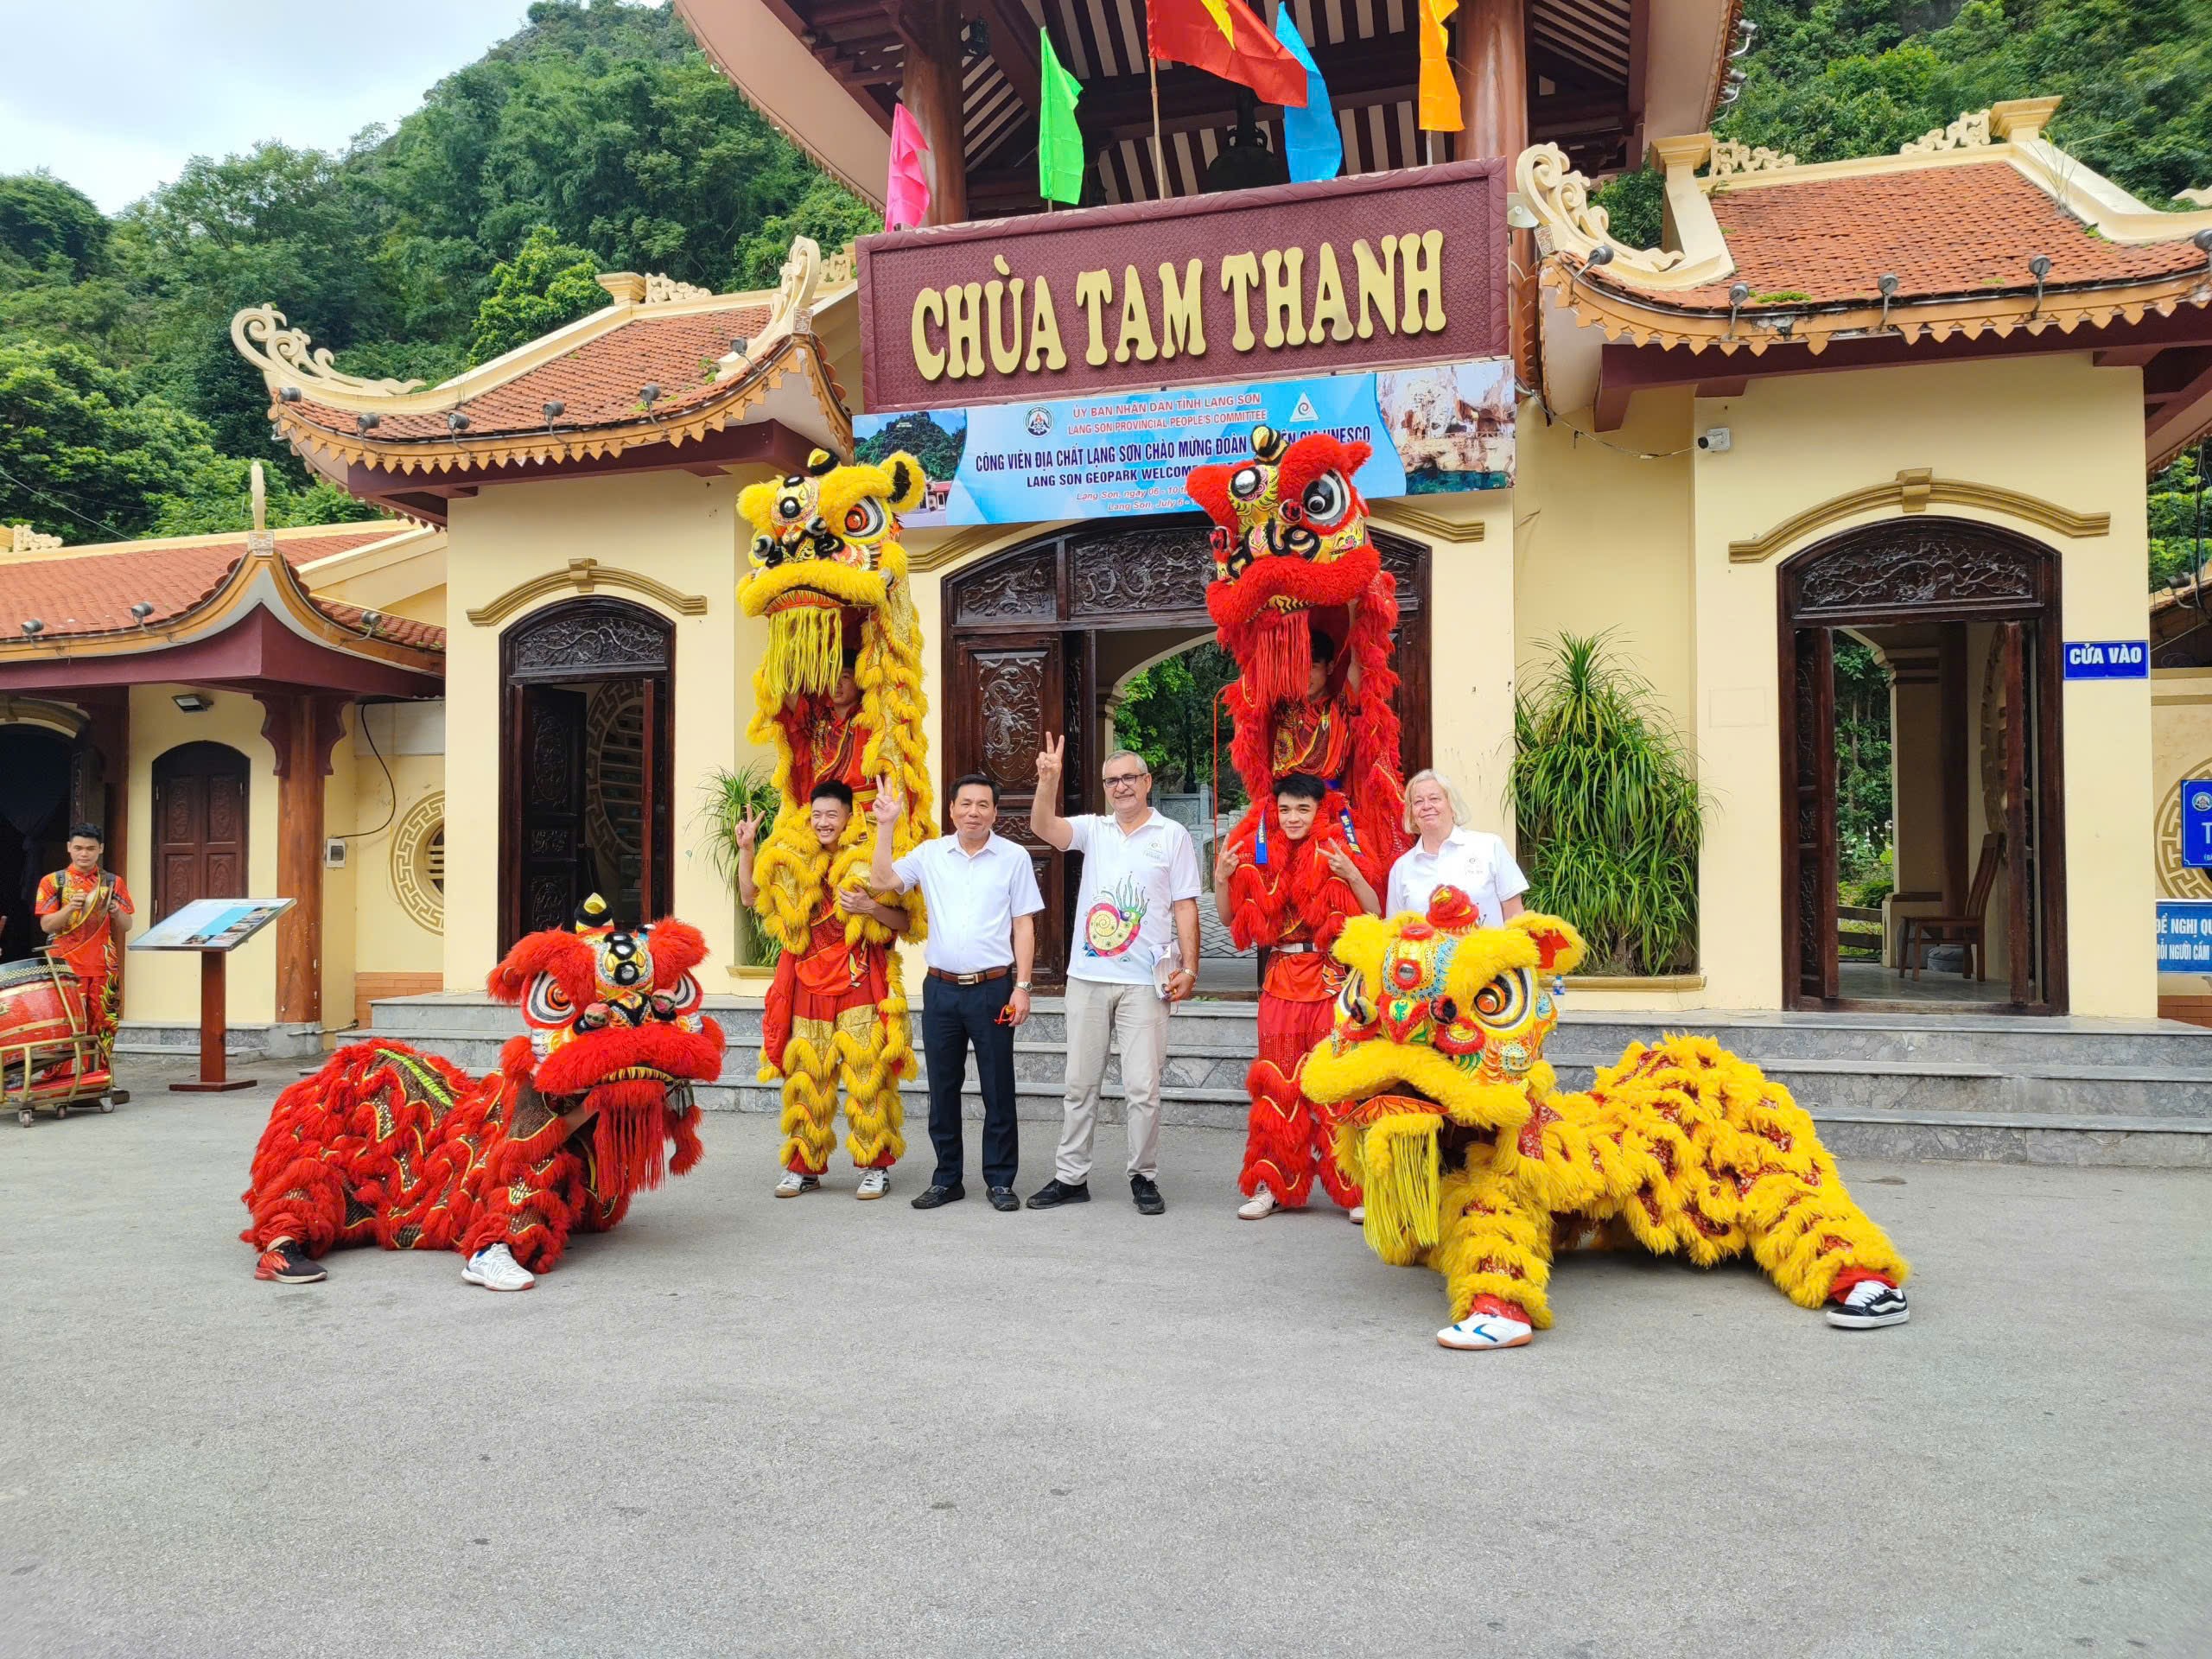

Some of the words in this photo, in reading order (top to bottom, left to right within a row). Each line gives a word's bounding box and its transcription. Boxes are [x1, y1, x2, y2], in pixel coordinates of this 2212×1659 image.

[911, 254, 1067, 381] CHÙA
[1076, 257, 1206, 366] TAM
[1221, 229, 1446, 352] THANH
[1091, 406, 1113, 417] BAN
[1116, 402, 1147, 415] NHÂN
[1150, 399, 1173, 412] DÂN
[1205, 396, 1234, 410] LẠNG
[1237, 393, 1260, 404] SƠN
[1068, 423, 1092, 435] LANG
[1094, 423, 1112, 433] SON
[1115, 417, 1167, 431] PROVINCIAL
[1170, 415, 1211, 427] PEOPLE'S
[1214, 410, 1266, 423] COMMITTEE
[976, 452, 1004, 472] CÔNG
[1007, 449, 1032, 470] VIÊN
[1035, 450, 1052, 471] ĐỊA
[1056, 442, 1084, 466] CHẤT
[1087, 447, 1116, 468] LẠNG
[1119, 443, 1141, 462] SƠN
[1145, 438, 1174, 460] CHÀO
[1179, 435, 1212, 458] MỪNG
[1216, 432, 1247, 454] ĐOÀN
[1027, 474, 1056, 487] LANG
[1059, 473, 1082, 486] SON
[1085, 468, 1138, 484] GEOPARK
[1141, 464, 1198, 480] WELCOM
[1156, 499, 1175, 508] July
[2069, 643, 2105, 664] CỬA
[2108, 644, 2142, 664] VÀO
[2171, 918, 2198, 938] NGHỊ
[2169, 939, 2192, 960] NGƯỜI
